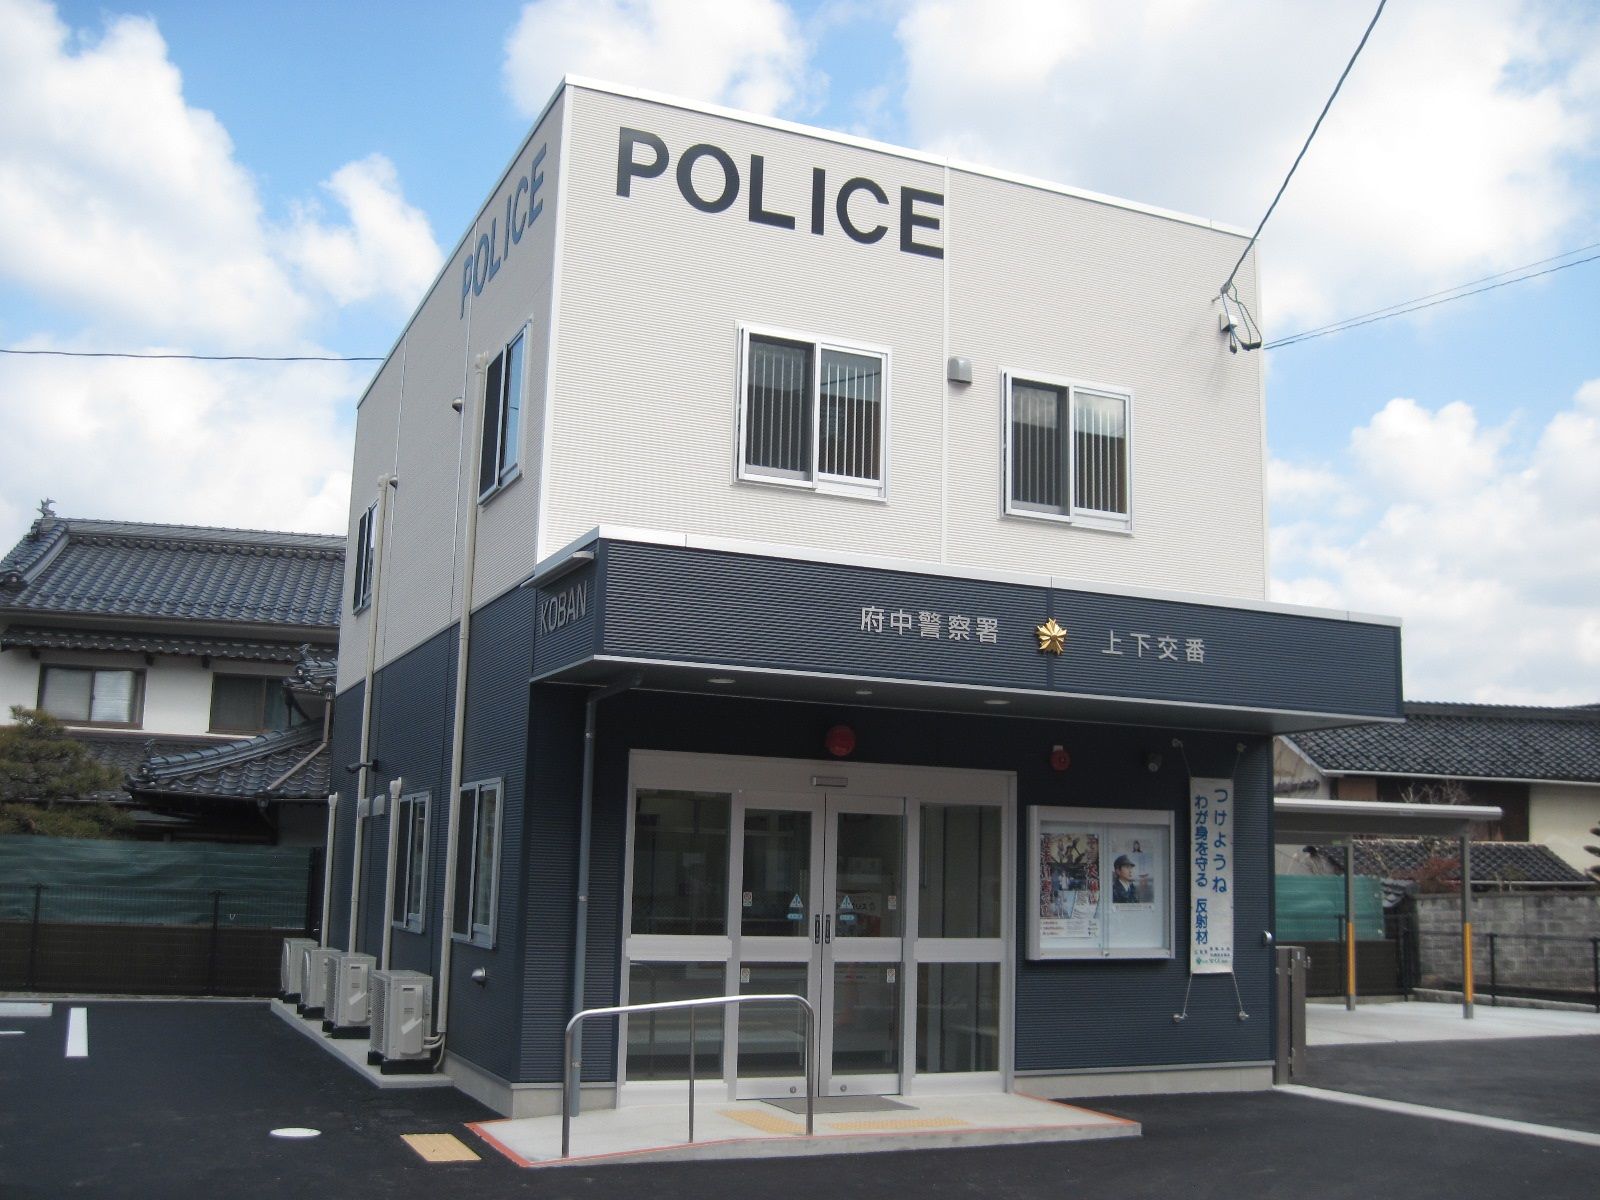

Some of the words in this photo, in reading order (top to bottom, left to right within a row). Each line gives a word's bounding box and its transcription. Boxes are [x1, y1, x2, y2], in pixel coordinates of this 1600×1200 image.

[459, 142, 547, 321] POLICE
[616, 126, 944, 260] POLICE
[540, 580, 588, 637] KOBAN
[861, 606, 998, 643] 府中警察署
[1102, 630, 1204, 663] 上下交番
[1194, 795, 1208, 887] わが身を守る
[1213, 788, 1229, 893] つけようね
[1195, 899, 1208, 945] 反射材
